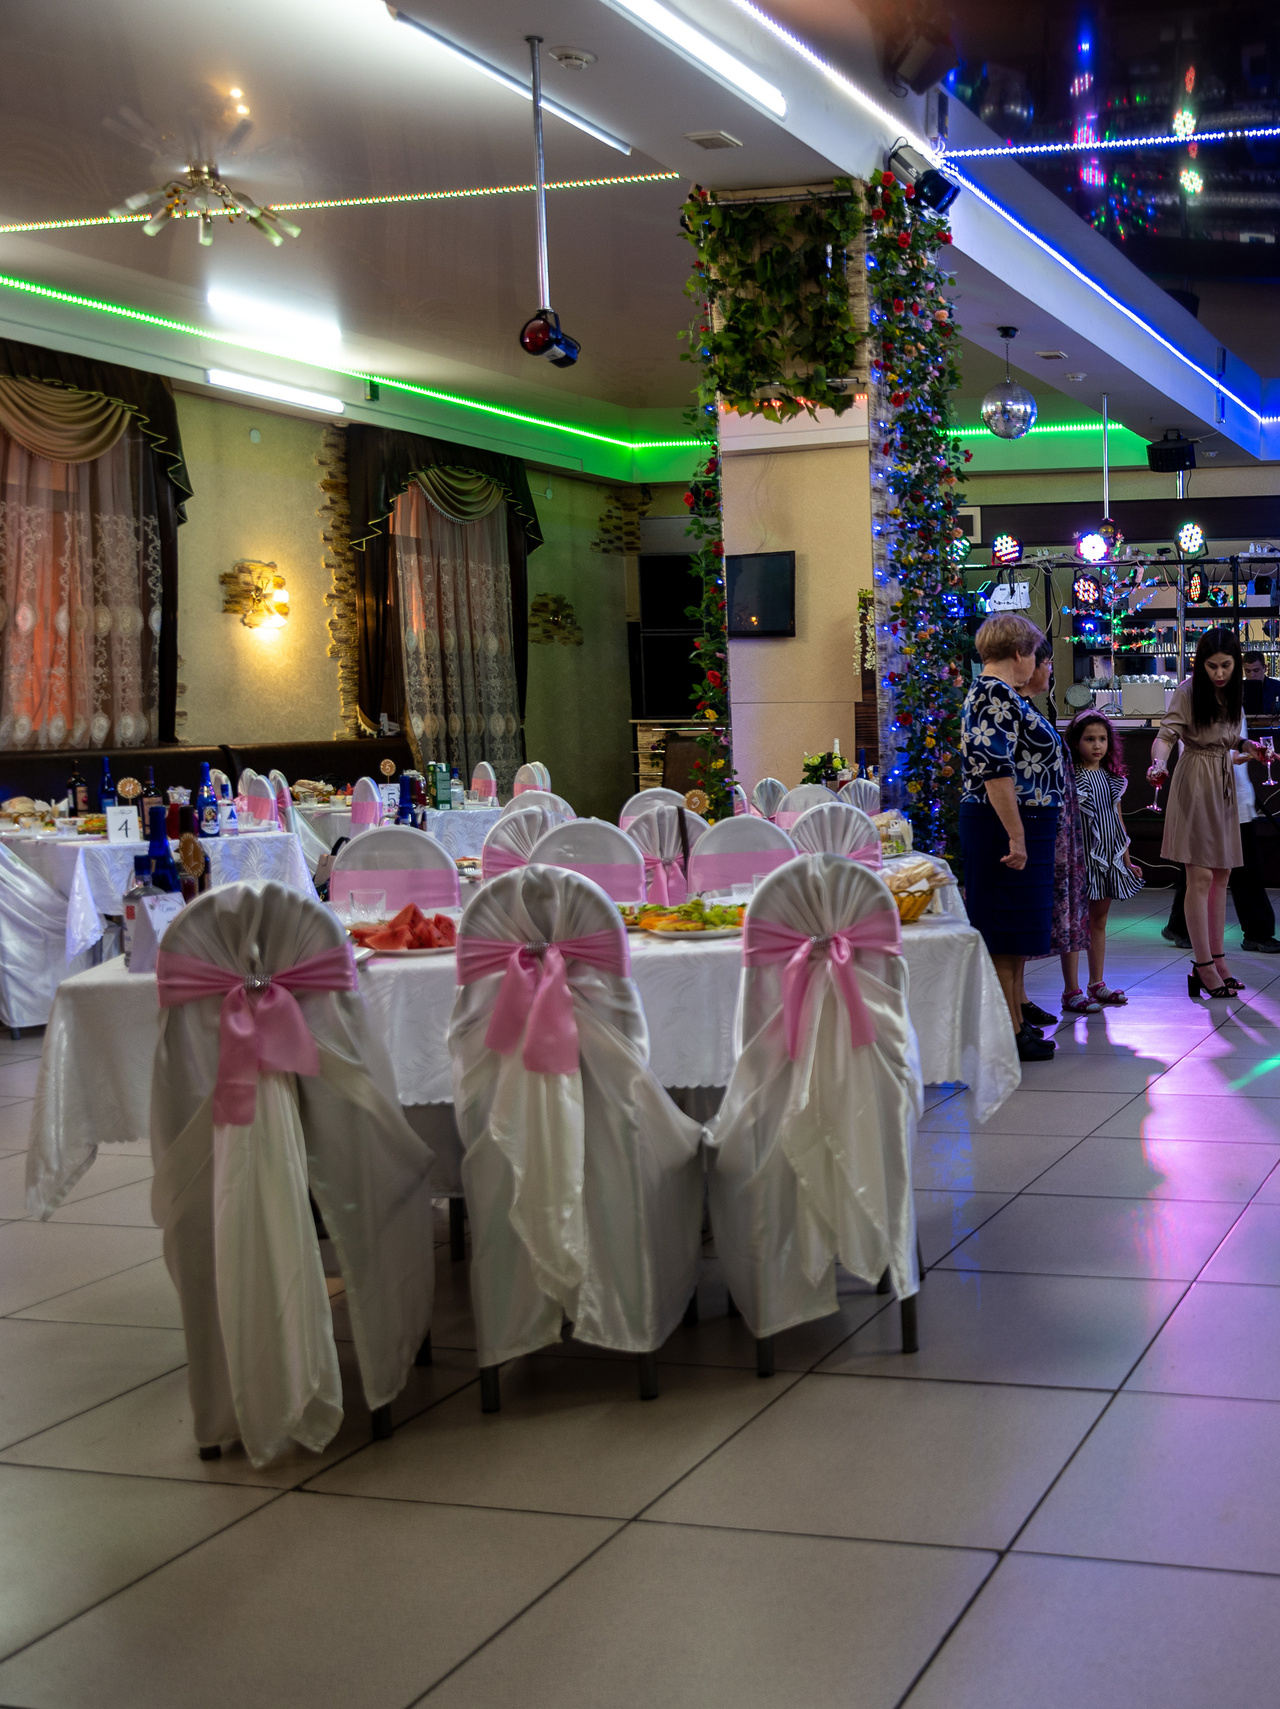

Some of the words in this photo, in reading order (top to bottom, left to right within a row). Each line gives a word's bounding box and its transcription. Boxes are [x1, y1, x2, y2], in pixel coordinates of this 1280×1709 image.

[387, 792, 397, 809] 5
[691, 796, 700, 809] 3
[118, 819, 132, 838] 4
